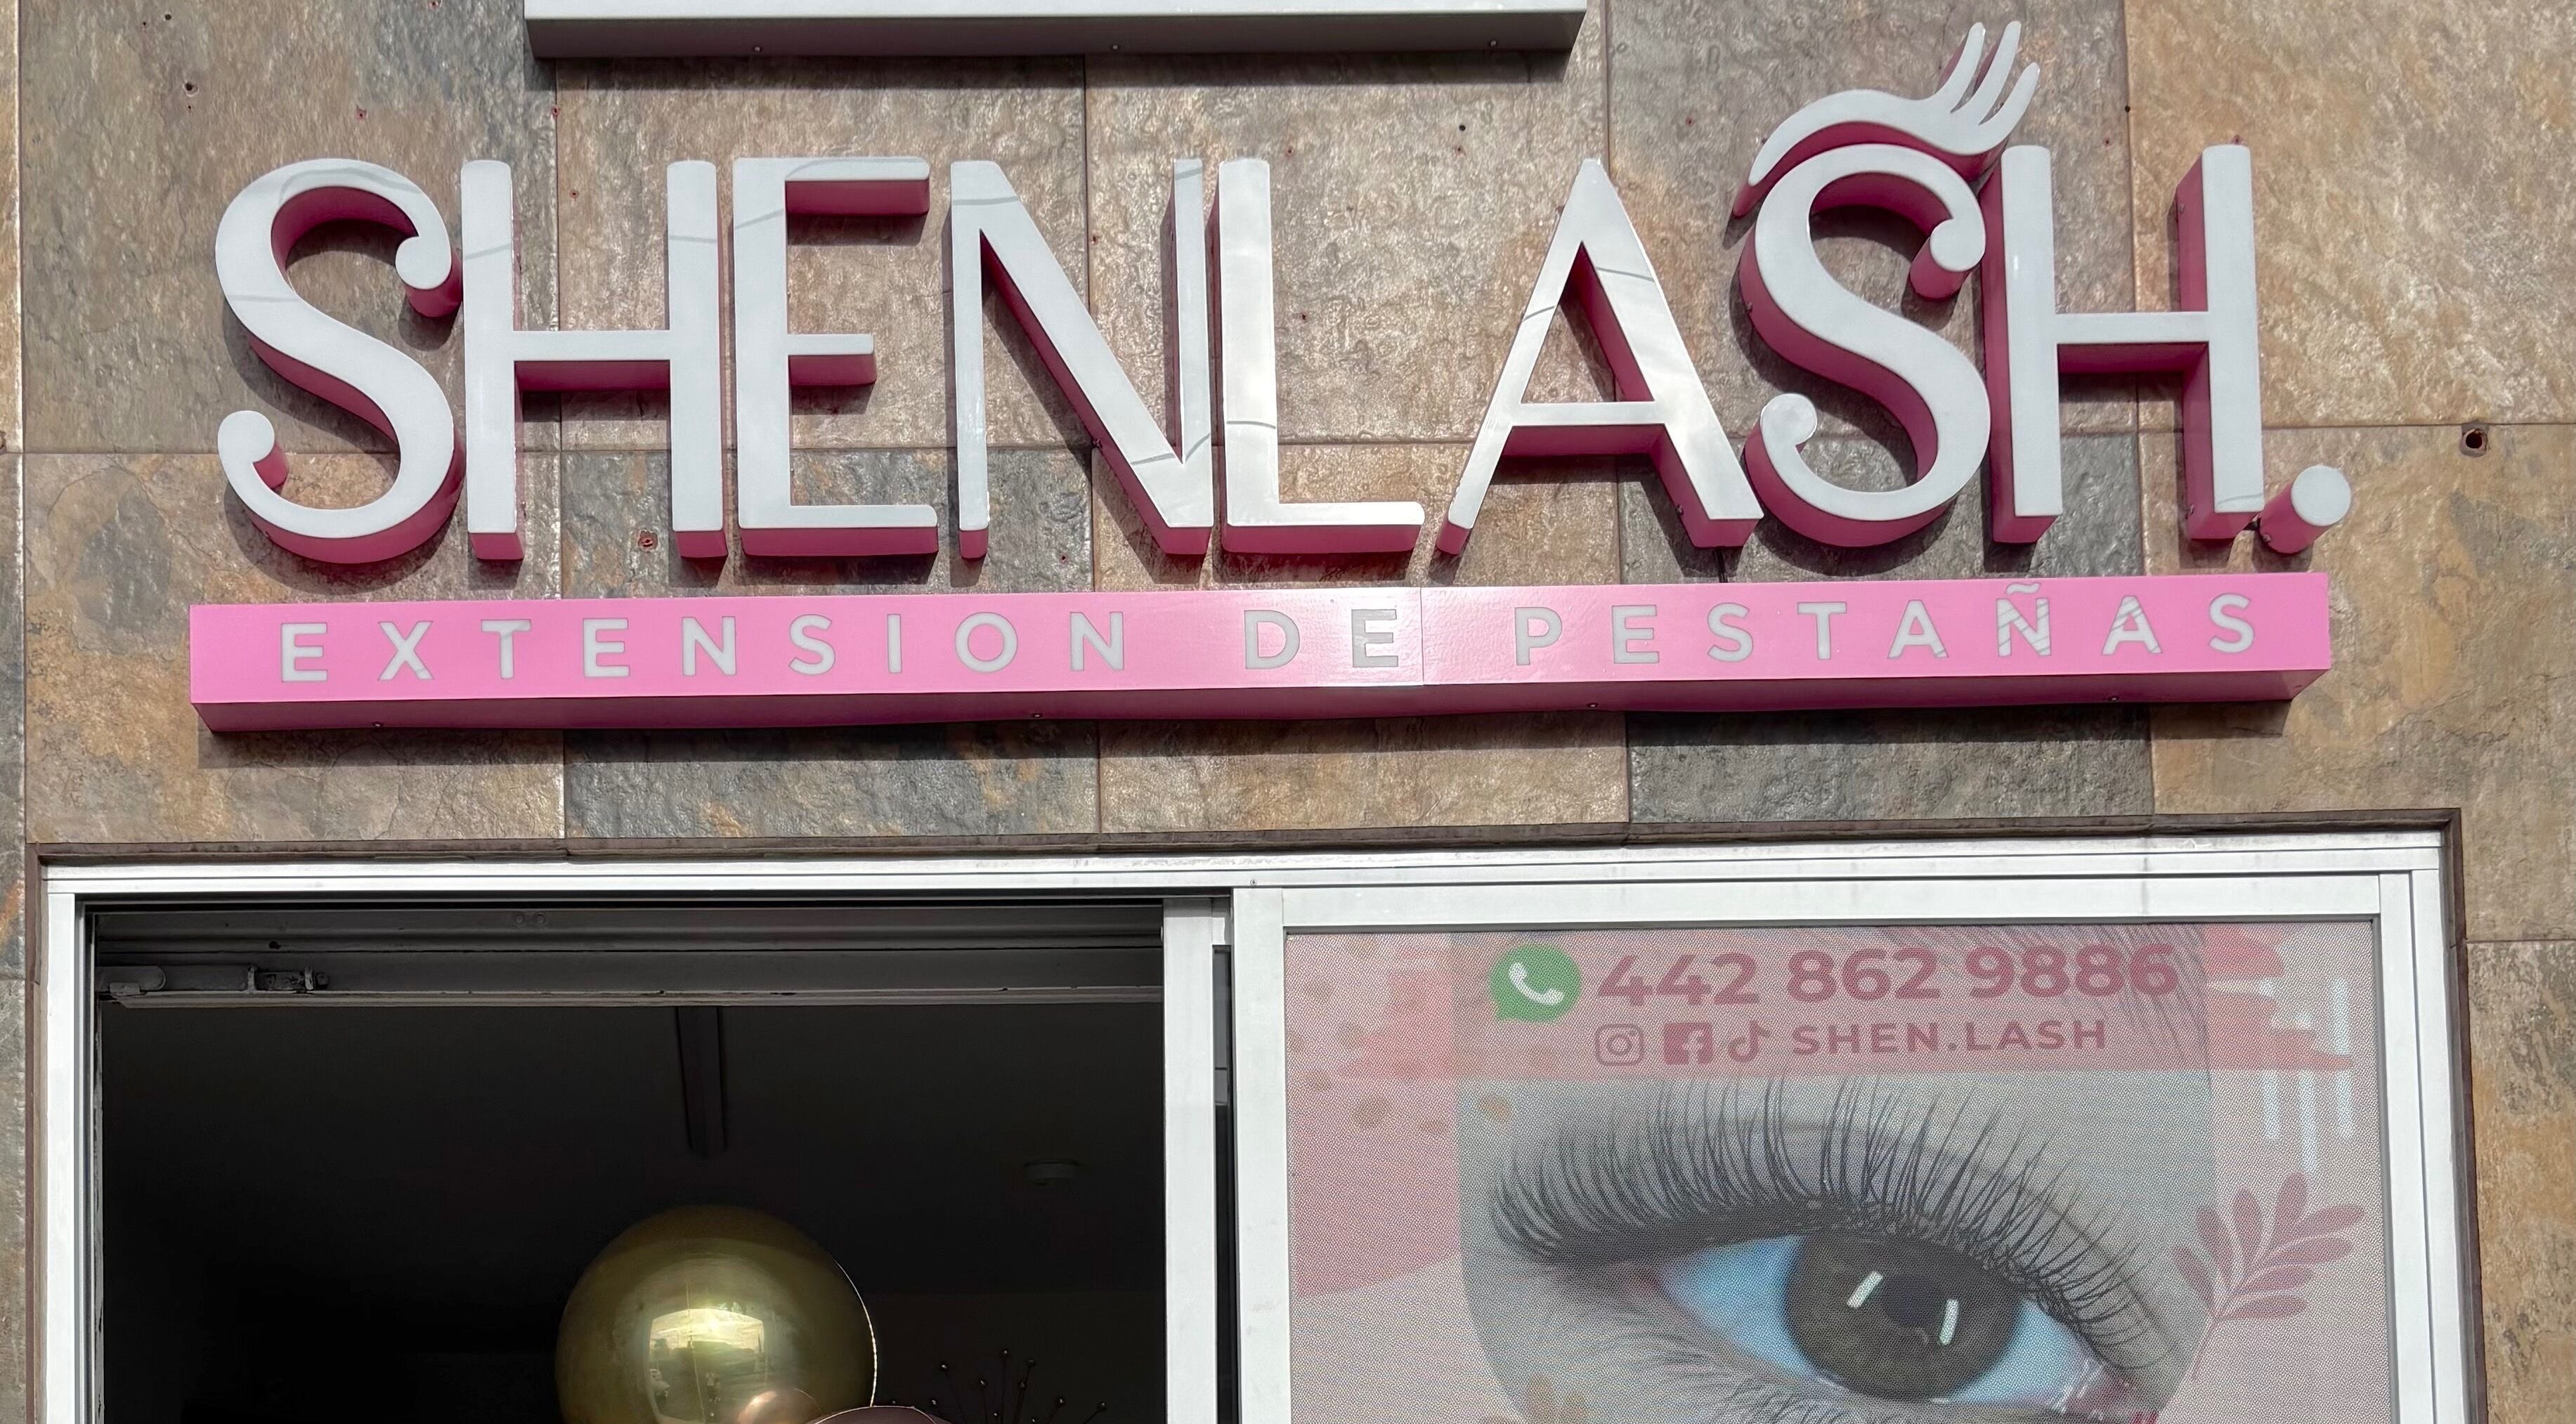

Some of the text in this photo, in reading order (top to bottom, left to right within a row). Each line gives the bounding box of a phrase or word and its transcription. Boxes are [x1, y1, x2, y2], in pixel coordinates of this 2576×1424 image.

[280, 583, 2256, 683] EXTENSION DE PESTAÑAS
[1596, 943, 2177, 1007] 442 862 9886
[1791, 1019, 2107, 1055] SHEN.LASH
